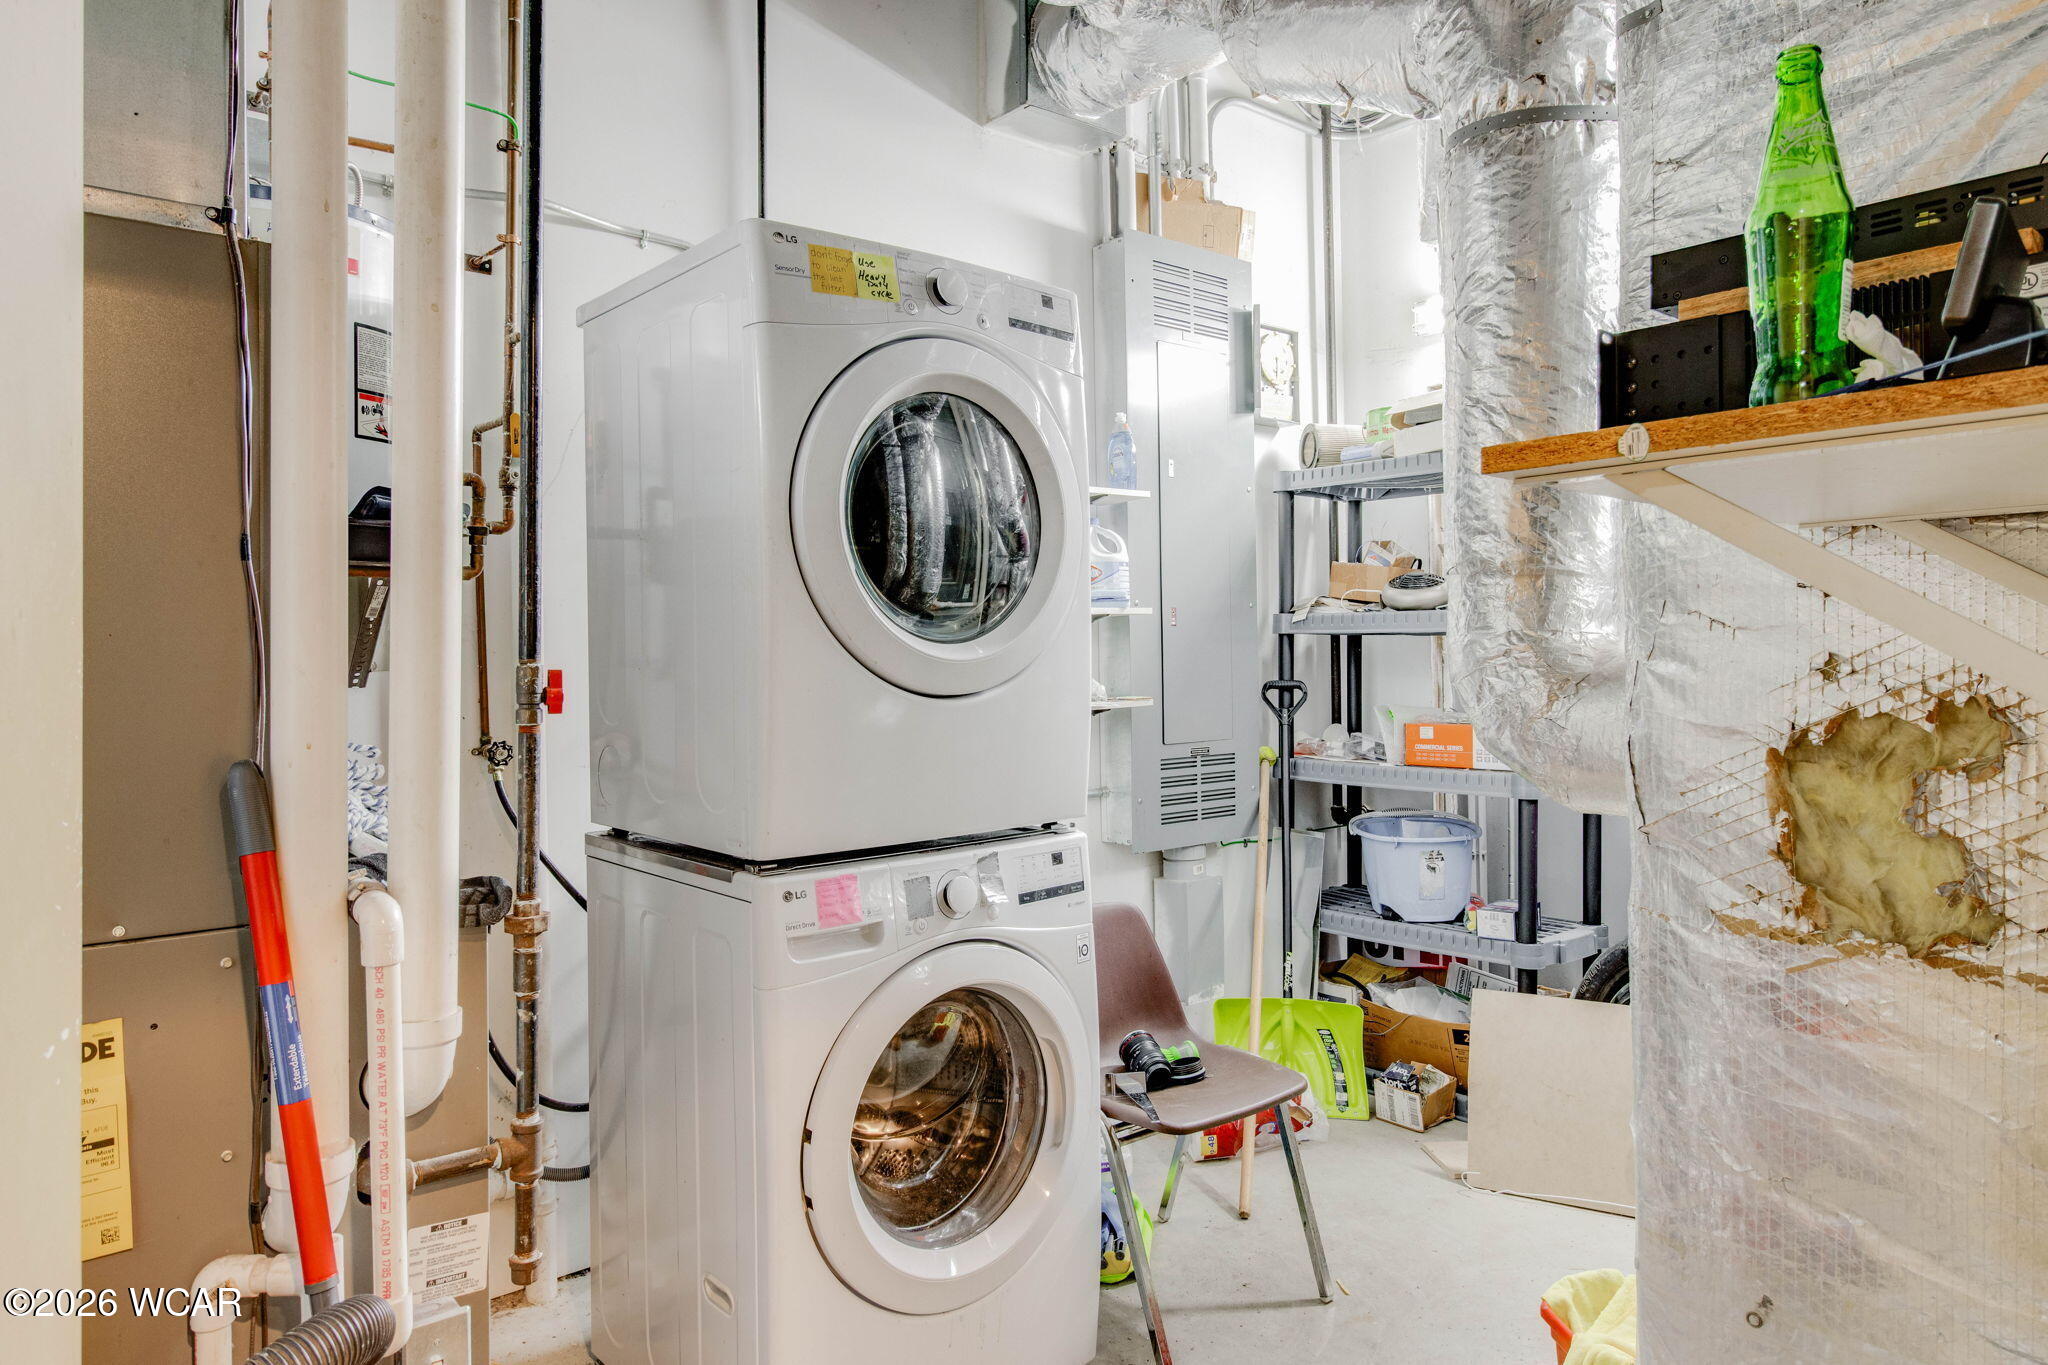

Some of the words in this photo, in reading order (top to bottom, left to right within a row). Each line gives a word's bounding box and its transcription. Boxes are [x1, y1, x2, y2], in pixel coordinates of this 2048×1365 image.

[785, 234, 798, 244] LG
[858, 257, 876, 269] Use
[858, 269, 886, 283] Heavy
[1414, 743, 1444, 751] COMMERCIAL
[795, 890, 807, 900] LG
[785, 923, 801, 932] Direct
[802, 921, 816, 929] Drive
[375, 987, 384, 999] 40
[375, 1008, 385, 1025] 480
[376, 1028, 386, 1043] PSI
[376, 1046, 387, 1059] PR
[287, 1044, 303, 1091] Extendable
[376, 1061, 387, 1098] WATER
[83, 1087, 99, 1095] this
[378, 1102, 388, 1115] AT
[96, 1147, 115, 1157] Most
[379, 1141, 389, 1160] PVC
[380, 1219, 391, 1247] ASTM
